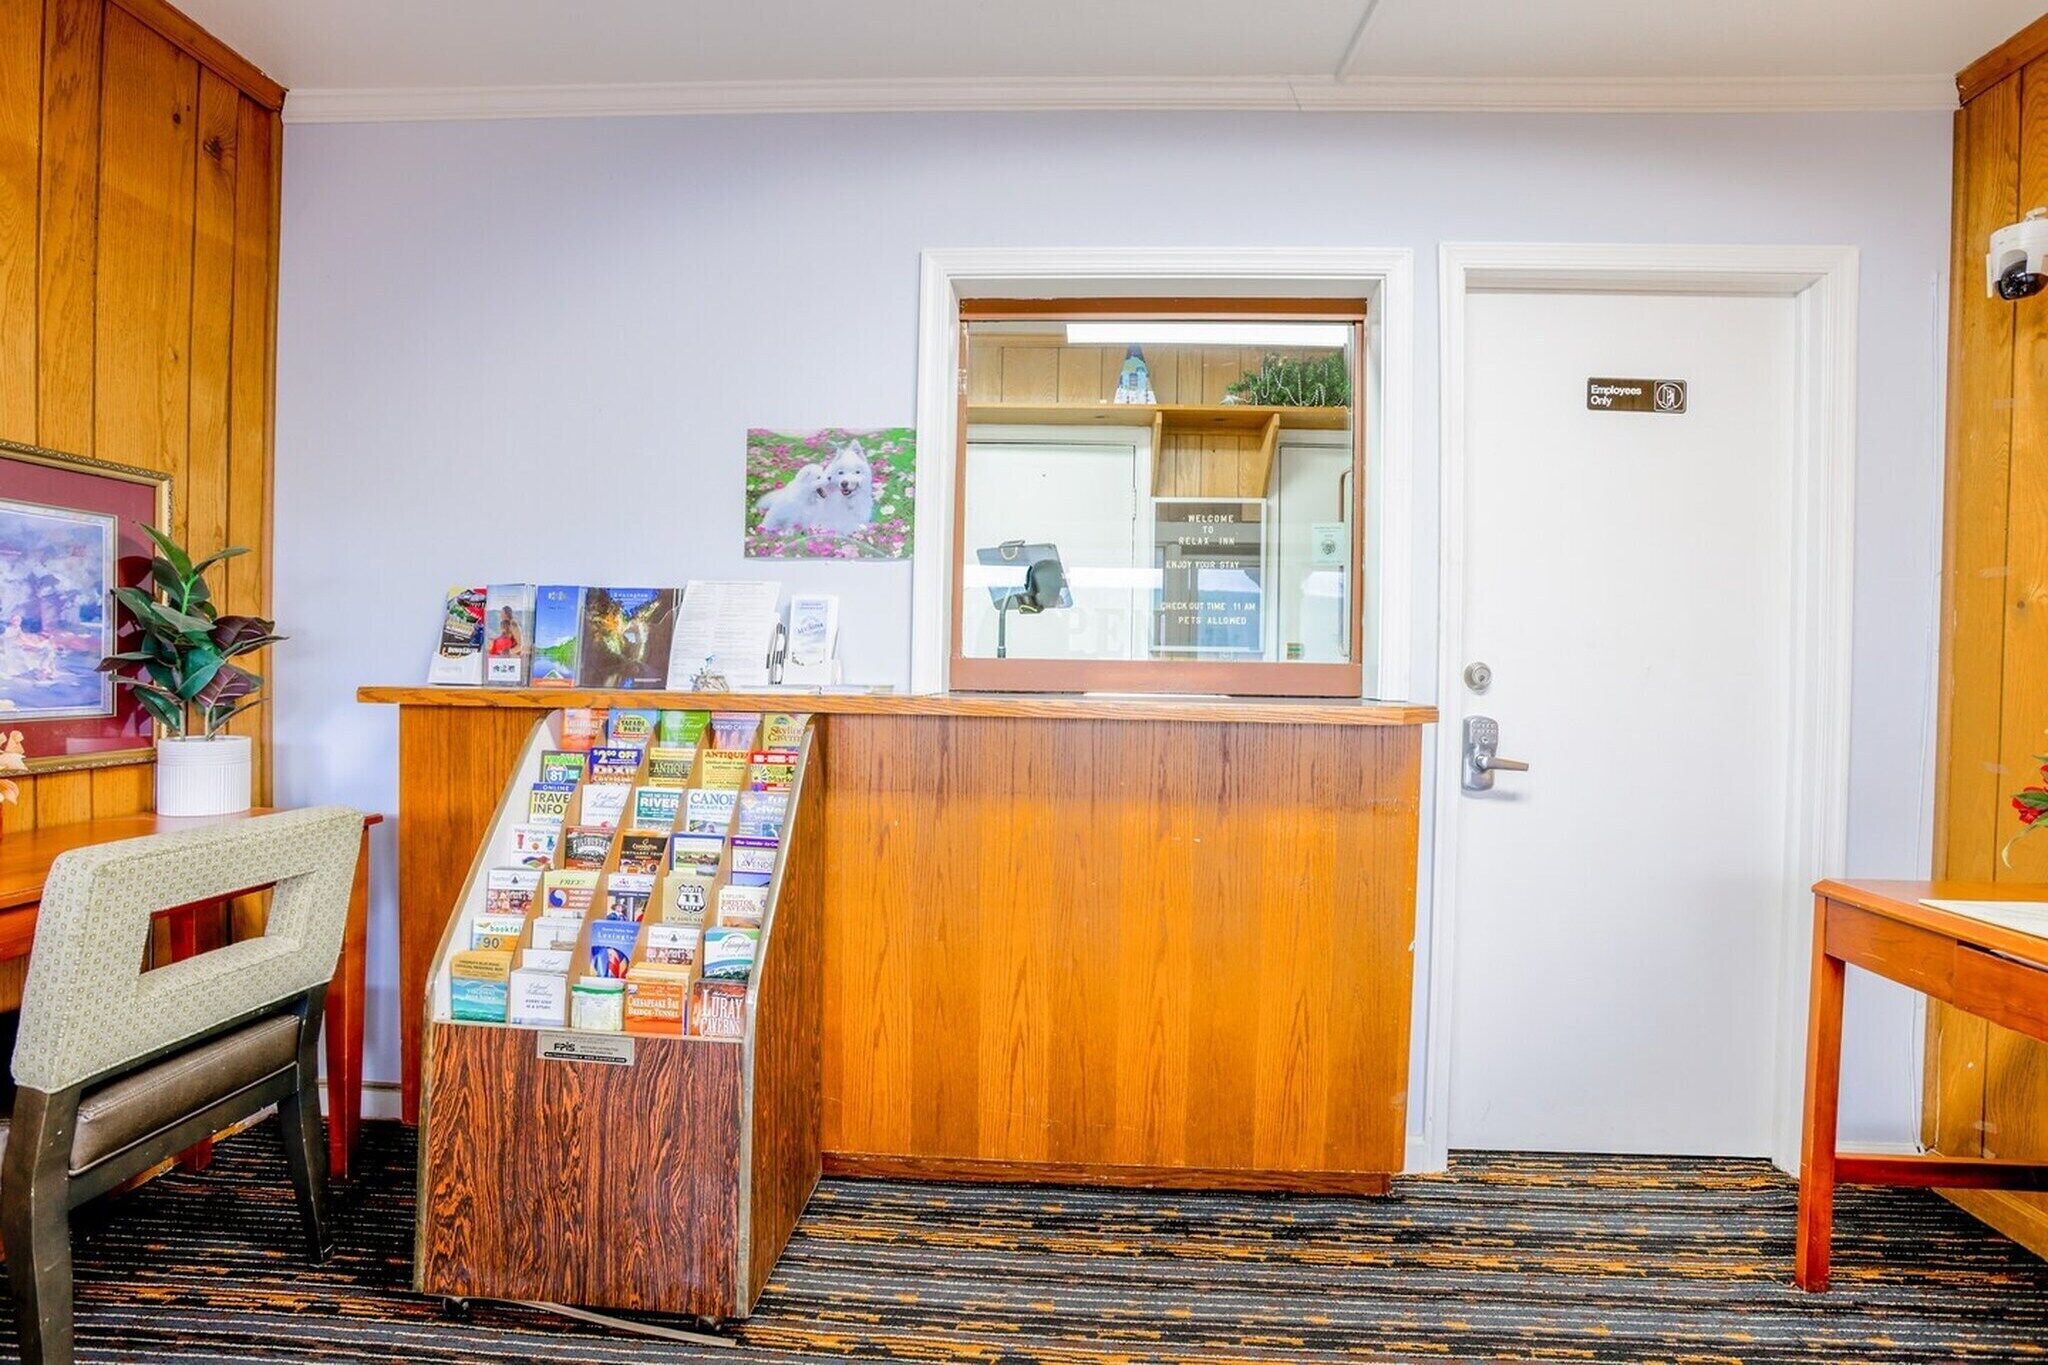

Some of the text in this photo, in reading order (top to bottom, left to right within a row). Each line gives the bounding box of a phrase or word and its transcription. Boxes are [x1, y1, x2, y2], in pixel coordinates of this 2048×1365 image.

[1591, 384, 1642, 396] Employees
[1590, 395, 1612, 408] Only
[1188, 514, 1234, 523] WELCOME
[1202, 525, 1214, 534] TO
[1178, 536, 1235, 545] RELAX INN
[1165, 560, 1240, 569] ENJOY YOUR STAY
[1205, 602, 1226, 611] TIME
[1233, 602, 1242, 610] 11
[1243, 602, 1256, 611] AM
[1178, 616, 1247, 625] PETS ALLOWED
[550, 771, 563, 781] 81
[533, 792, 570, 804] TRAVE
[533, 804, 563, 814] INFO
[683, 894, 699, 903] 11
[700, 989, 743, 1020] LURAY
[700, 1017, 742, 1038] CAVERNS
